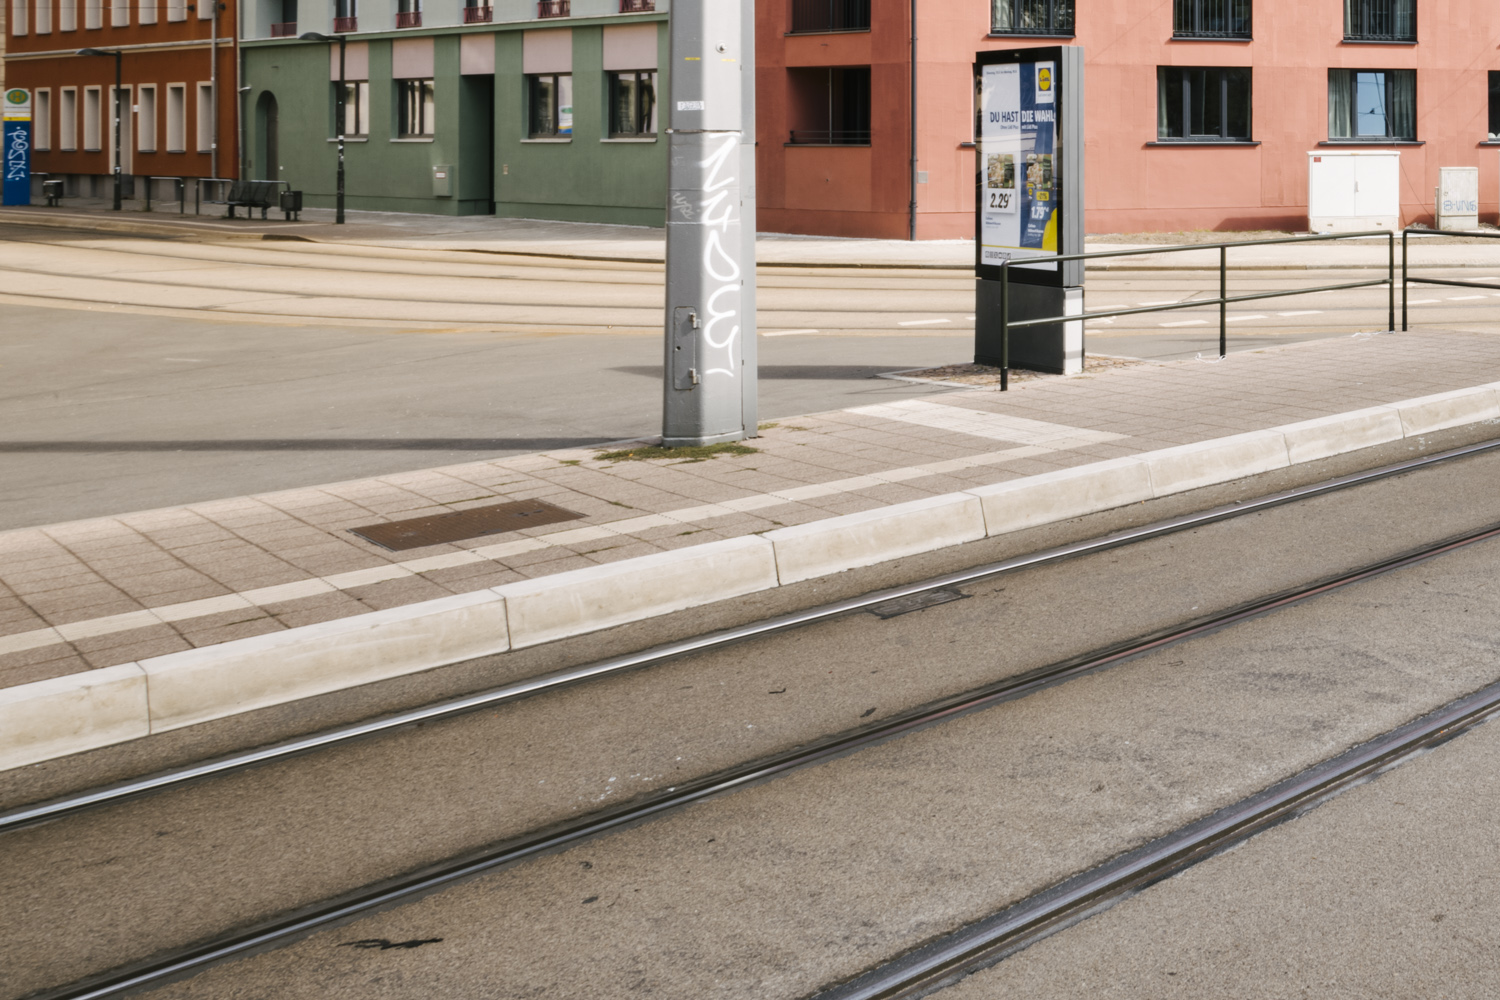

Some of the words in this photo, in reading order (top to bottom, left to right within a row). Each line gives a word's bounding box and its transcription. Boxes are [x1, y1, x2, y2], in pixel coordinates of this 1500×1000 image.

[990, 111, 1000, 123] DU
[1001, 111, 1019, 122] HAST
[1021, 110, 1034, 122] DIE
[1035, 110, 1055, 122] WAHL
